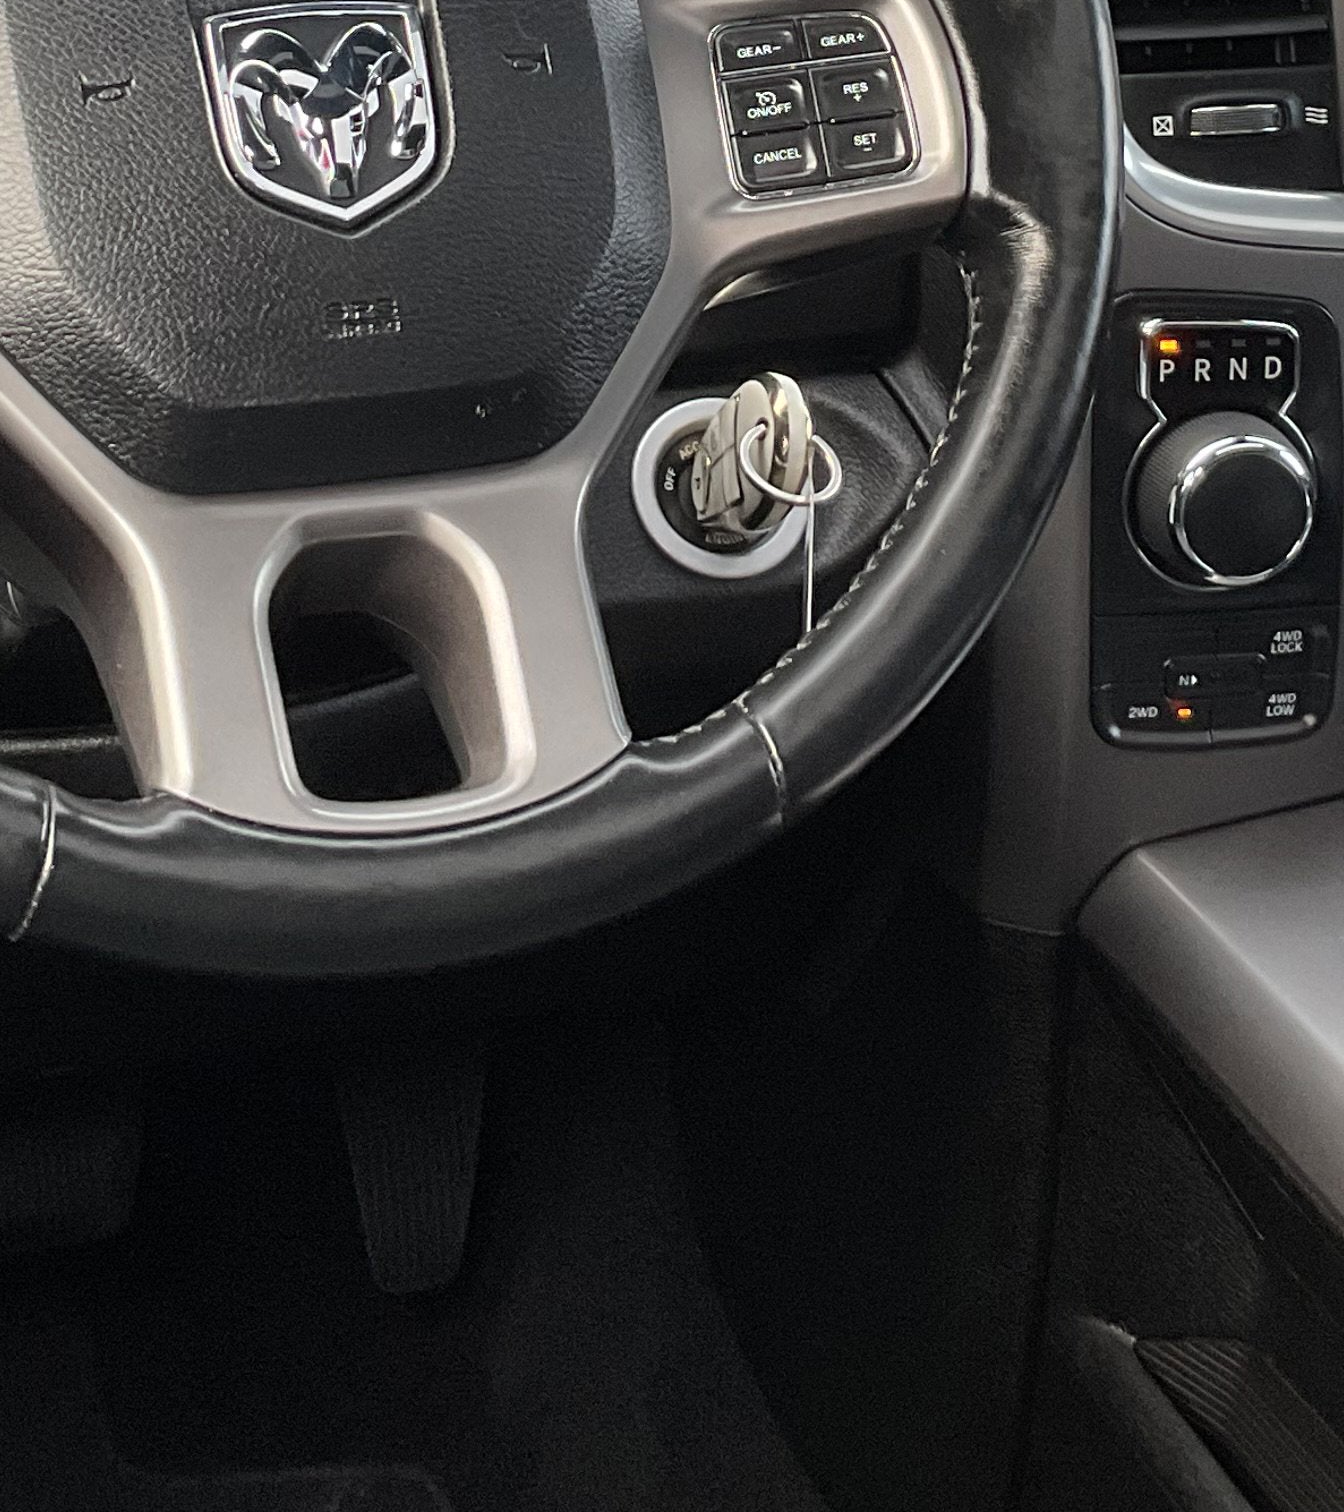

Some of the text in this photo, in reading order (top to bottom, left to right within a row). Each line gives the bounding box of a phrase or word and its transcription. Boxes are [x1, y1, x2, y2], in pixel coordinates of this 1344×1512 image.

[843, 82, 869, 94] RES
[747, 101, 792, 119] ON/OFF
[854, 133, 877, 146] SET
[753, 147, 802, 165] CANCEL
[1159, 356, 1282, 382] P R N D
[664, 467, 676, 491] OFF
[1273, 630, 1303, 641] 4WD
[1270, 641, 1303, 654] LOCK
[1178, 675, 1189, 686] N
[1268, 693, 1297, 704] 4WD
[1128, 706, 1159, 718] 2WD
[1266, 704, 1295, 717] LOW
